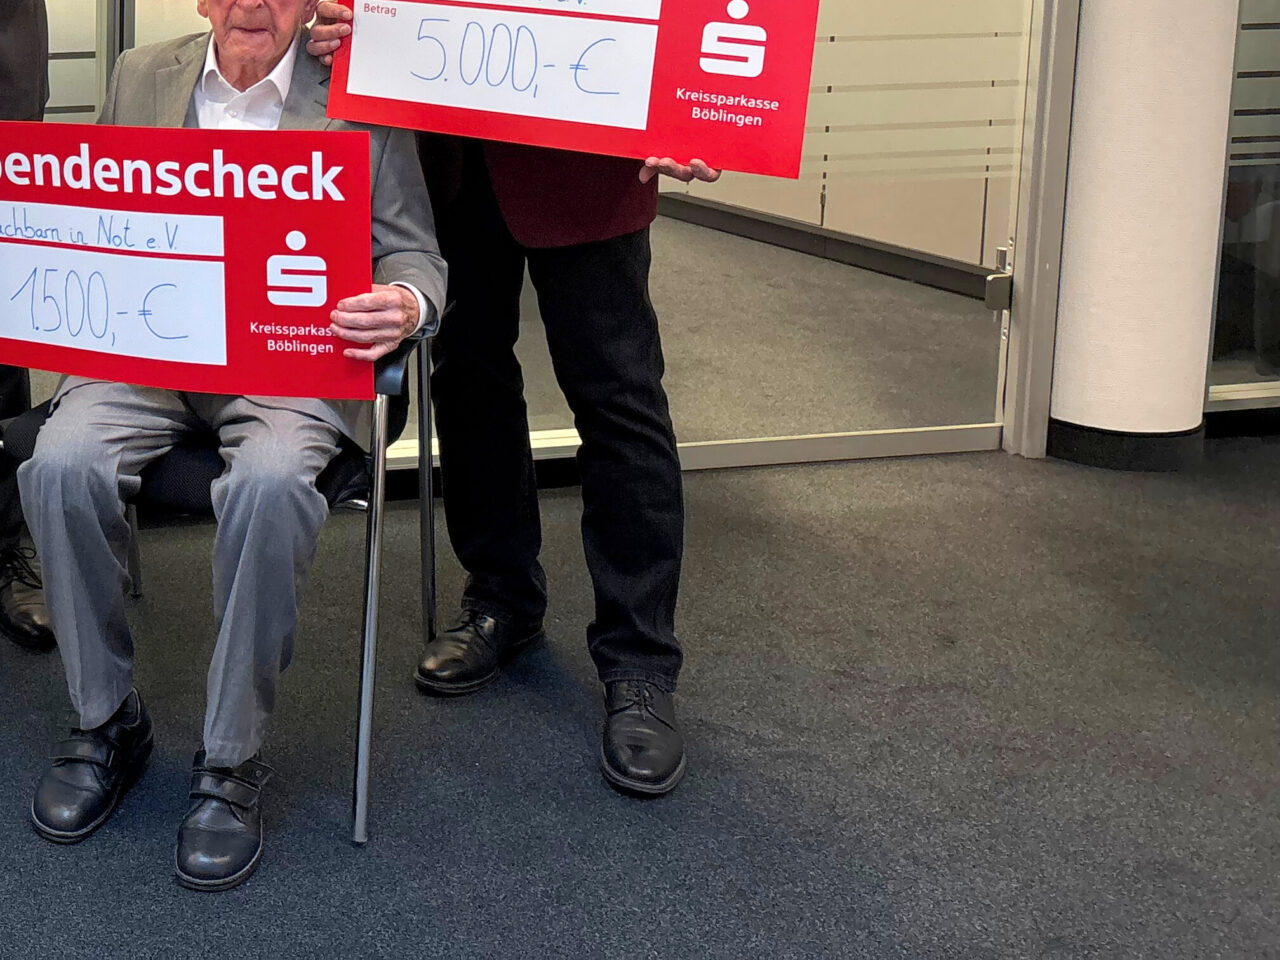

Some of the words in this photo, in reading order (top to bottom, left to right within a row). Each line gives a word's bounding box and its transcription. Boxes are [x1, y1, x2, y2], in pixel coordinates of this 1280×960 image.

[363, 2, 397, 17] Betrag
[676, 87, 779, 111] Kreissparkasse
[692, 106, 762, 127] Böblingen
[70, 227, 88, 245] in
[97, 214, 135, 248] Not
[250, 321, 336, 338] Kreissparkas
[267, 339, 334, 356] Böblingen
